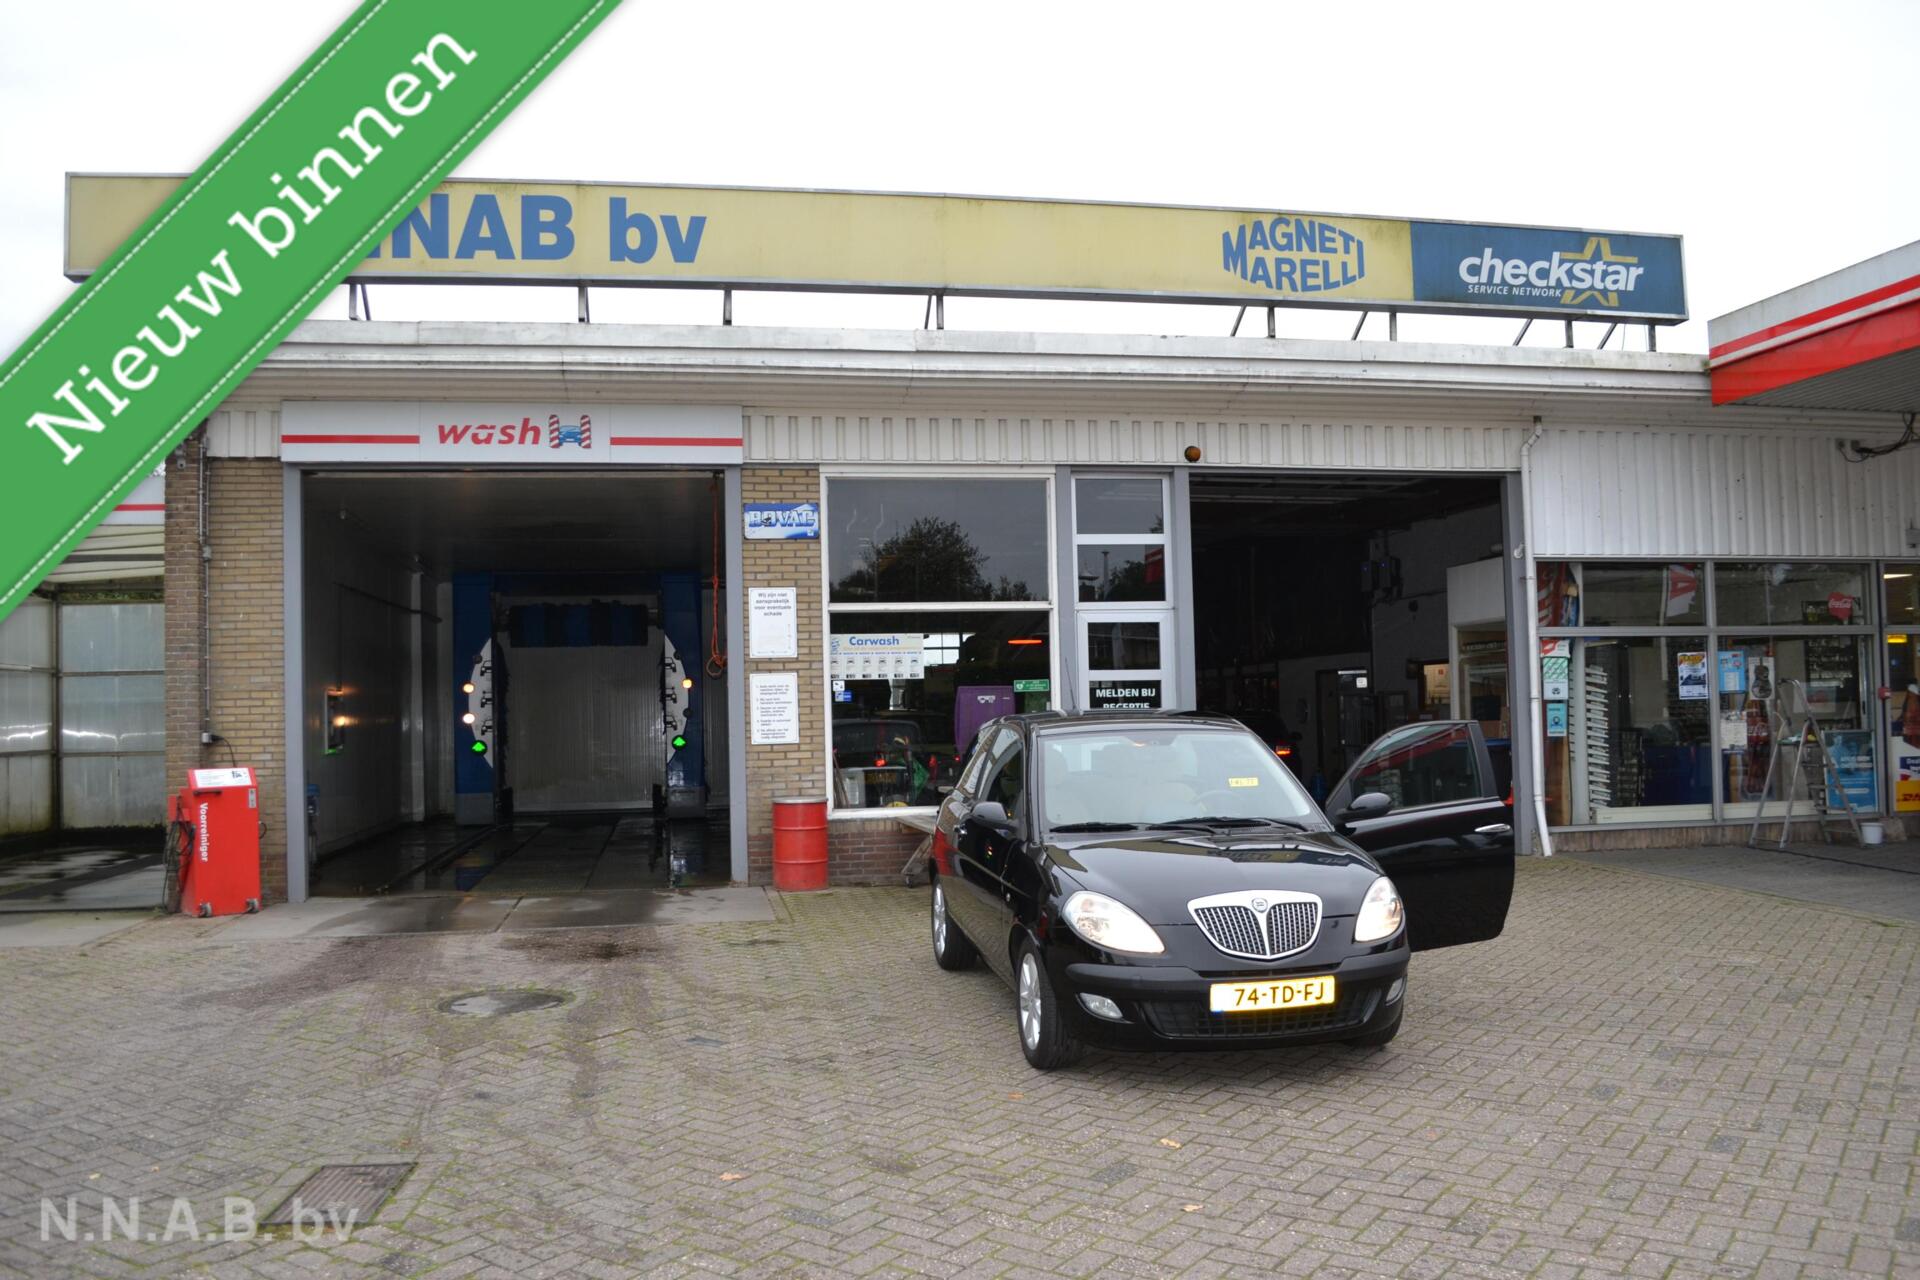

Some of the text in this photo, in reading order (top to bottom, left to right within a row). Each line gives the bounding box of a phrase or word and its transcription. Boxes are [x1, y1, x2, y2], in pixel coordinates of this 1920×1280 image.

[365, 193, 707, 264] NAB bv
[1458, 248, 1644, 292] checkstar
[1467, 284, 1562, 298] SERVICE NETWORK
[438, 417, 541, 445] wash
[849, 635, 899, 646] Carwash
[1096, 688, 1156, 698] MELDEN BIJ
[200, 802, 209, 863] Voorreiniger
[1234, 982, 1324, 1007] 74-TD-FJ
